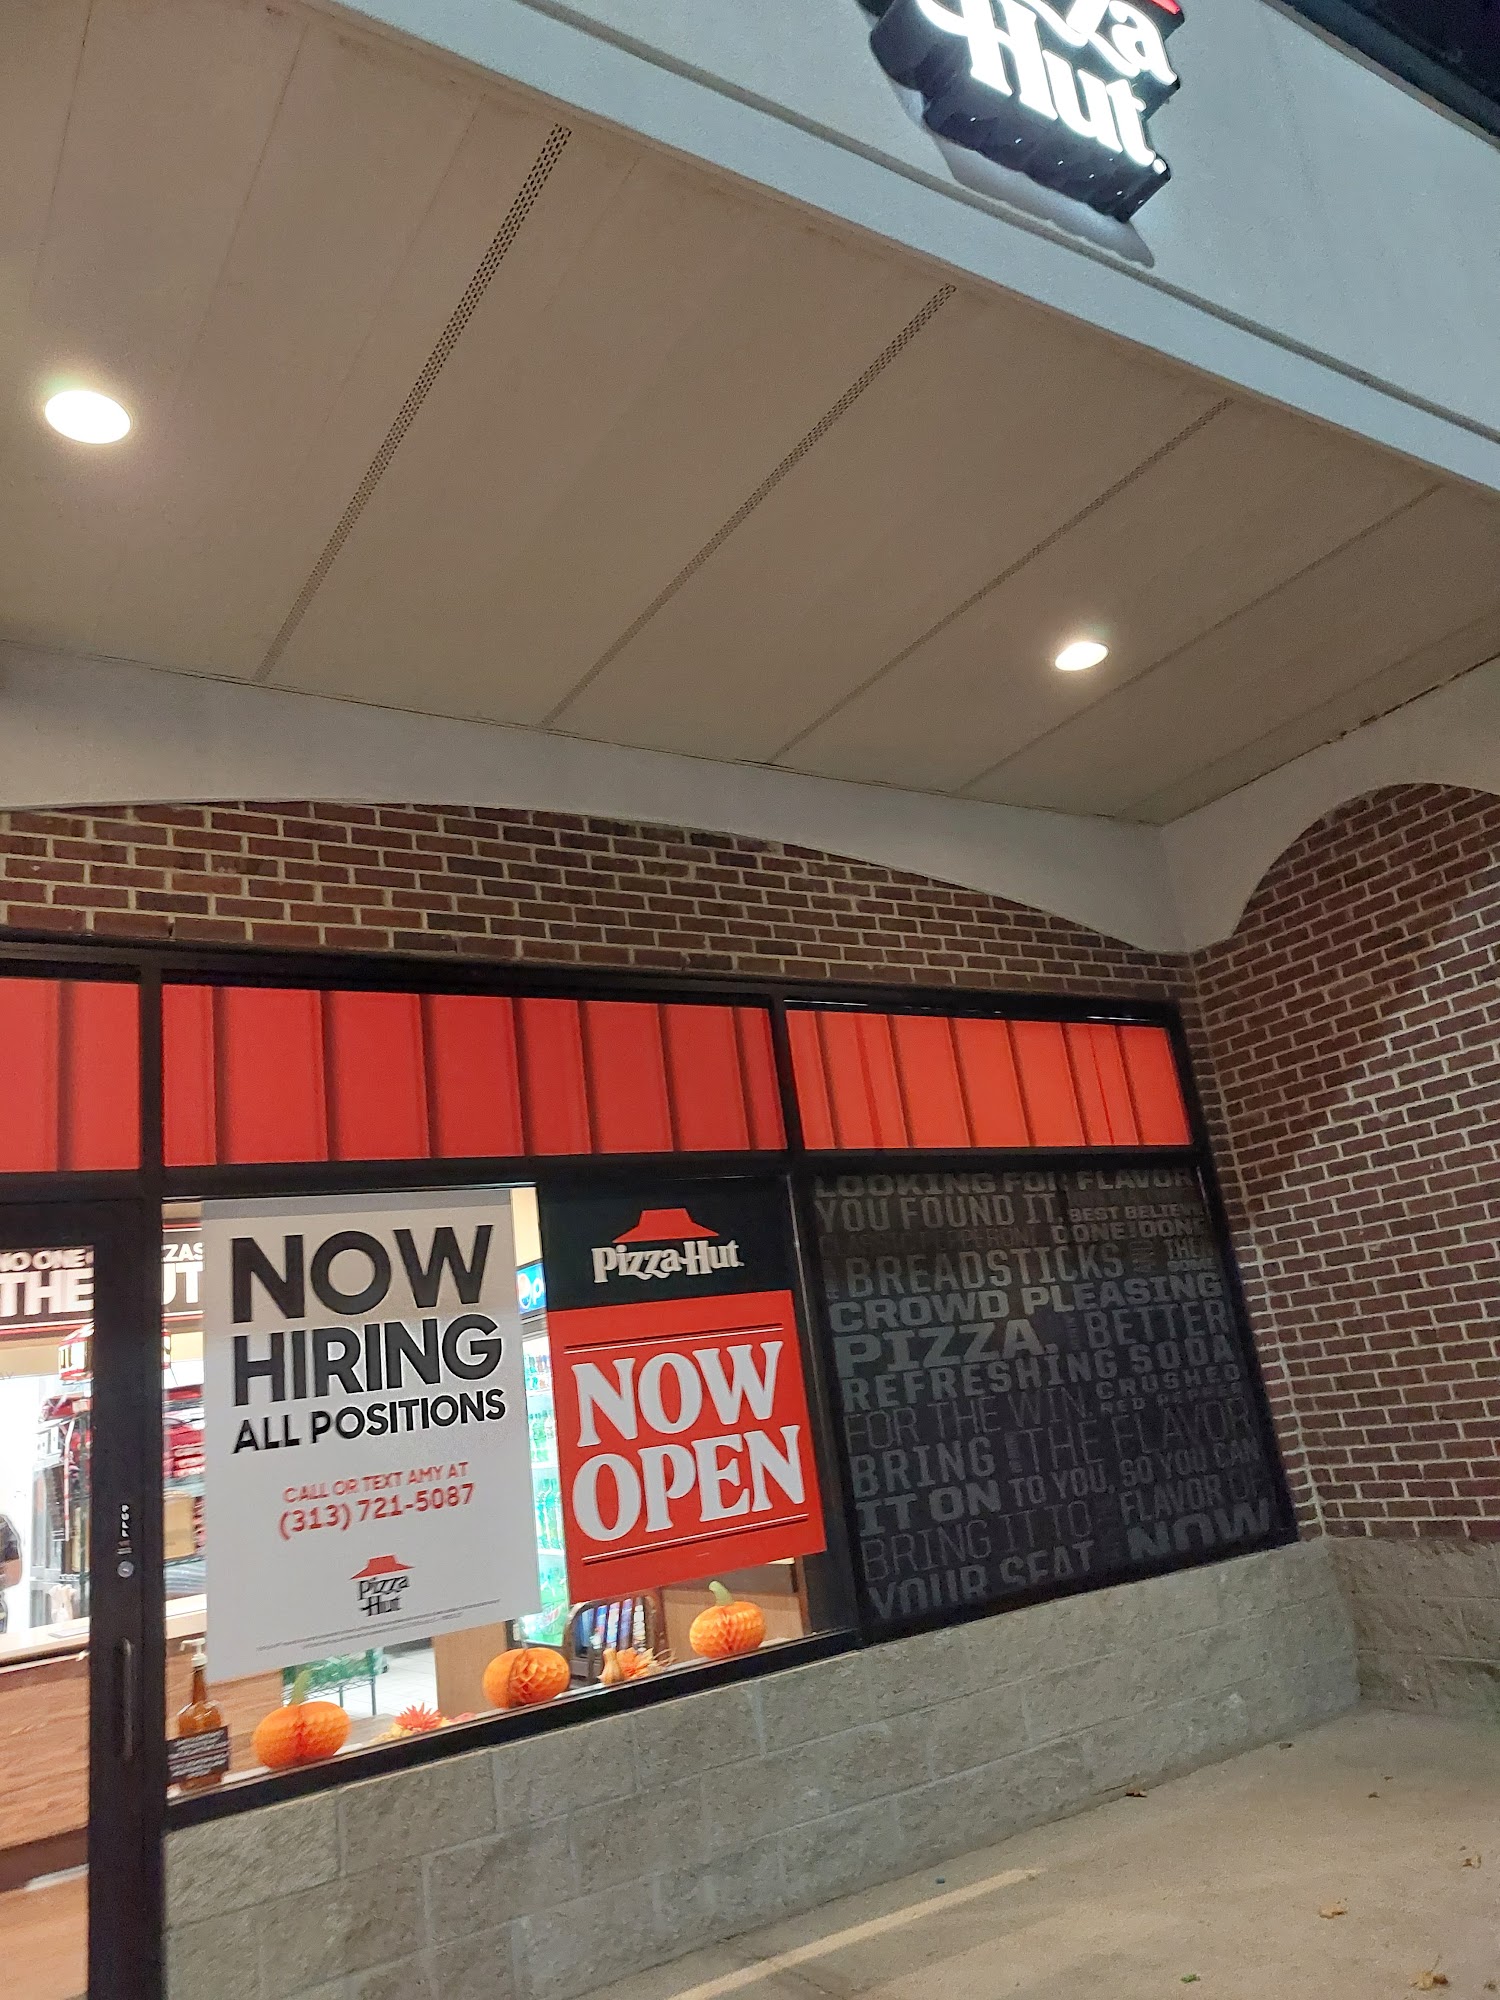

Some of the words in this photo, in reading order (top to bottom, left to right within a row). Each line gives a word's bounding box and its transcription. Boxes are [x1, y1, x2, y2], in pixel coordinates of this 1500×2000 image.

[814, 1173, 996, 1198] LOOKING
[814, 1197, 891, 1233] YOU
[900, 1194, 1015, 1230] FOUND
[1068, 1206, 1120, 1222] BEST
[162, 1243, 204, 1262] ZAS
[231, 1225, 494, 1324] NOW
[591, 1244, 683, 1283] Pizza
[679, 1239, 745, 1276] Hut
[846, 1243, 1124, 1298] BREADSTICKS
[0, 1267, 94, 1318] THE
[828, 1290, 1009, 1332] CROWD
[1021, 1272, 1223, 1315] PLEASING
[832, 1319, 1059, 1378] PIZZA.
[1084, 1300, 1229, 1349] BETTER
[234, 1314, 502, 1407] HIRING
[841, 1350, 1118, 1413] REFRESHING
[1128, 1334, 1235, 1374] SODA
[1096, 1363, 1240, 1400] CRUSHED
[232, 1414, 301, 1454] ALL
[310, 1388, 506, 1444] POSITIONS
[570, 1341, 784, 1448] NOW
[843, 1407, 920, 1454] FOR
[927, 1396, 1001, 1439] THE
[1007, 1386, 1093, 1430] WIN.
[1100, 1397, 1145, 1415] RED
[1019, 1420, 1104, 1473] THE
[1112, 1397, 1254, 1459] FLAVOR
[1119, 1456, 1154, 1487] SO
[1156, 1445, 1207, 1480] YOU
[1213, 1436, 1260, 1470] CAN
[283, 1482, 329, 1503] CALL
[332, 1478, 358, 1497] OR
[362, 1471, 403, 1492] TEXT
[407, 1465, 444, 1486] AMY
[447, 1461, 469, 1479] AT
[573, 1425, 805, 1541] OPEN
[851, 1436, 996, 1499] BRING
[278, 1503, 352, 1541] (313)
[357, 1482, 475, 1522] 721-5087
[855, 1493, 917, 1537] IT
[929, 1479, 1002, 1522] ON
[1008, 1474, 1046, 1507] TO
[1119, 1474, 1223, 1525] FLAVOR
[860, 1520, 992, 1582] BRING
[998, 1508, 1037, 1553] IT
[1044, 1500, 1092, 1540] TO
[357, 1575, 410, 1601] Pizza
